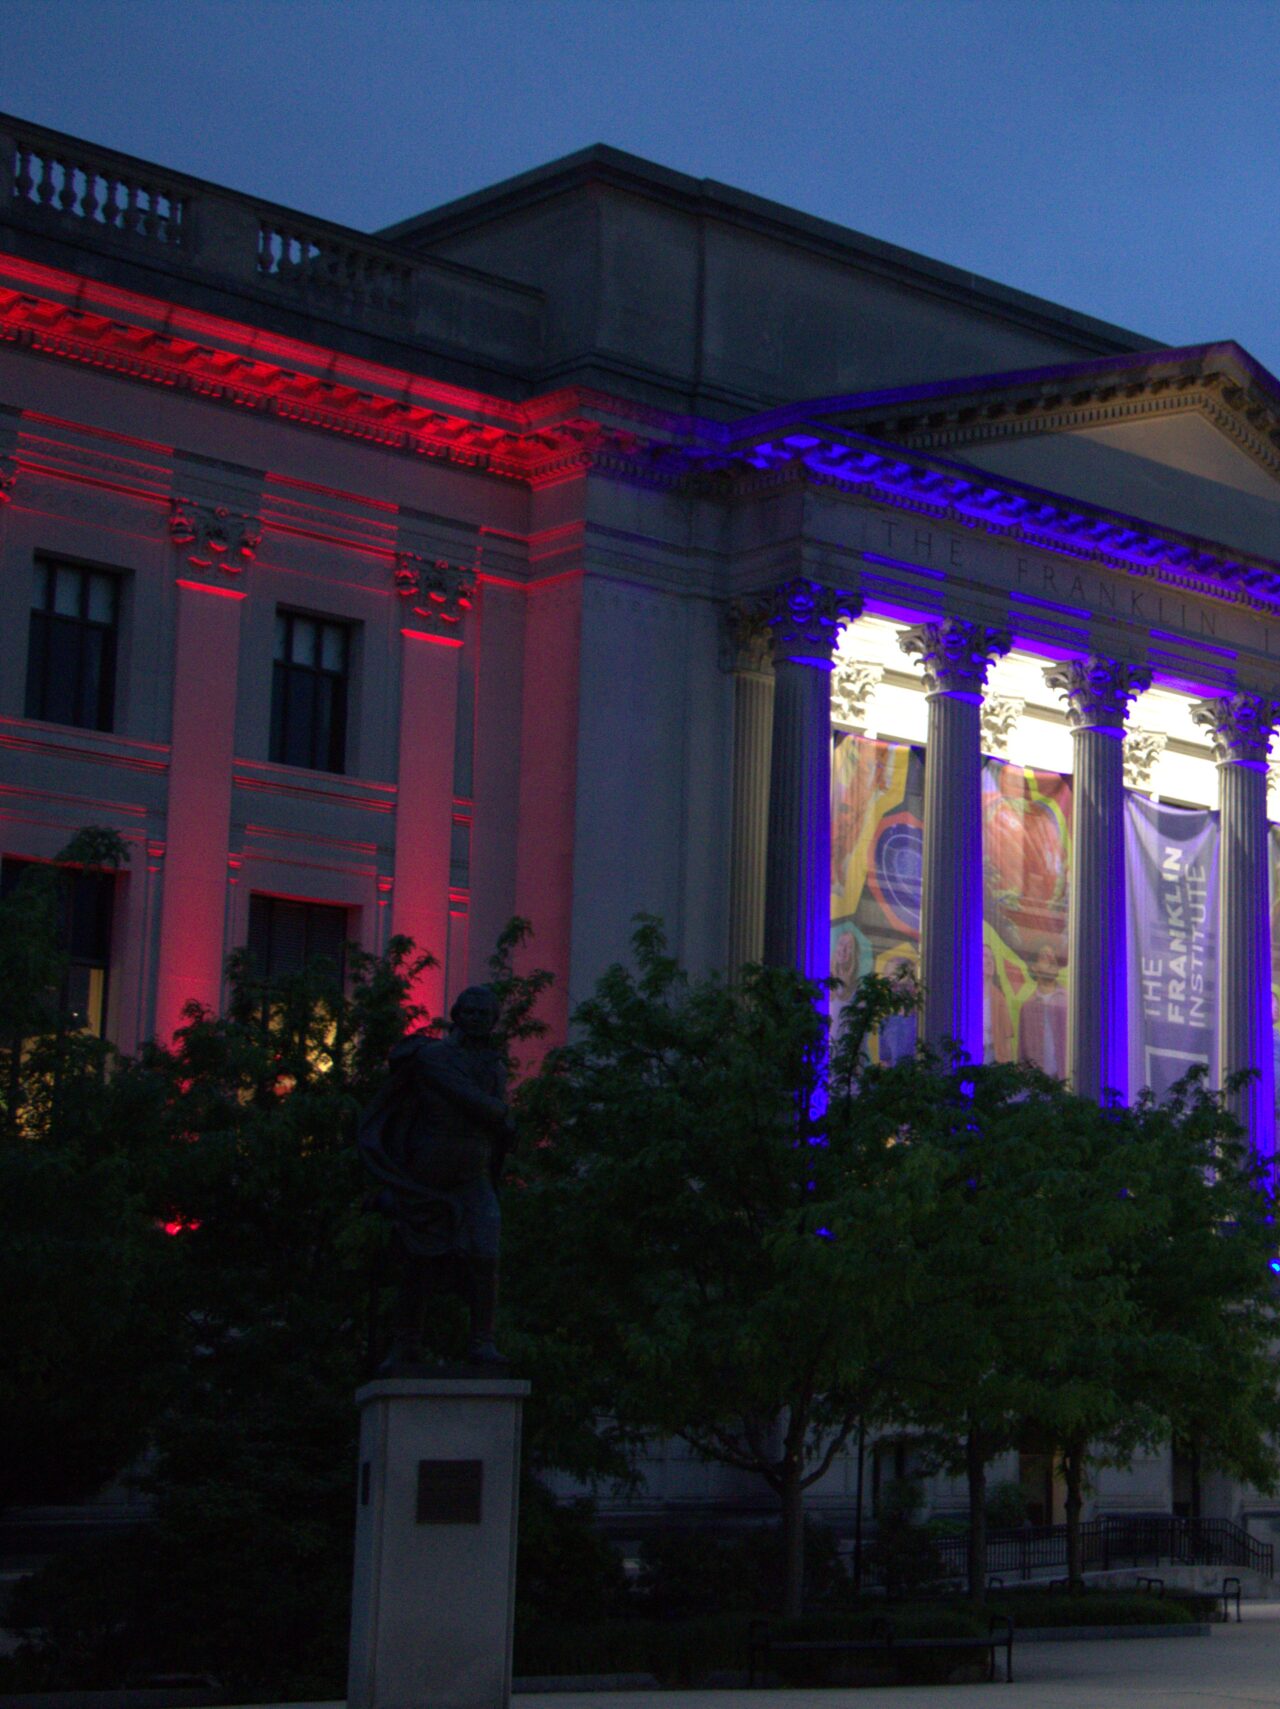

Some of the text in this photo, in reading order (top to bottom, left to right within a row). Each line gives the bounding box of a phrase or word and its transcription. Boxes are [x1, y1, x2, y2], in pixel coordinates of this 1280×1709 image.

[882, 519, 963, 567] THE
[1016, 557, 1217, 636] FRANKLIN
[1141, 956, 1163, 1016] THE
[1162, 846, 1187, 1025] FRANKLIN
[1184, 863, 1207, 1028] INSTITUTE
